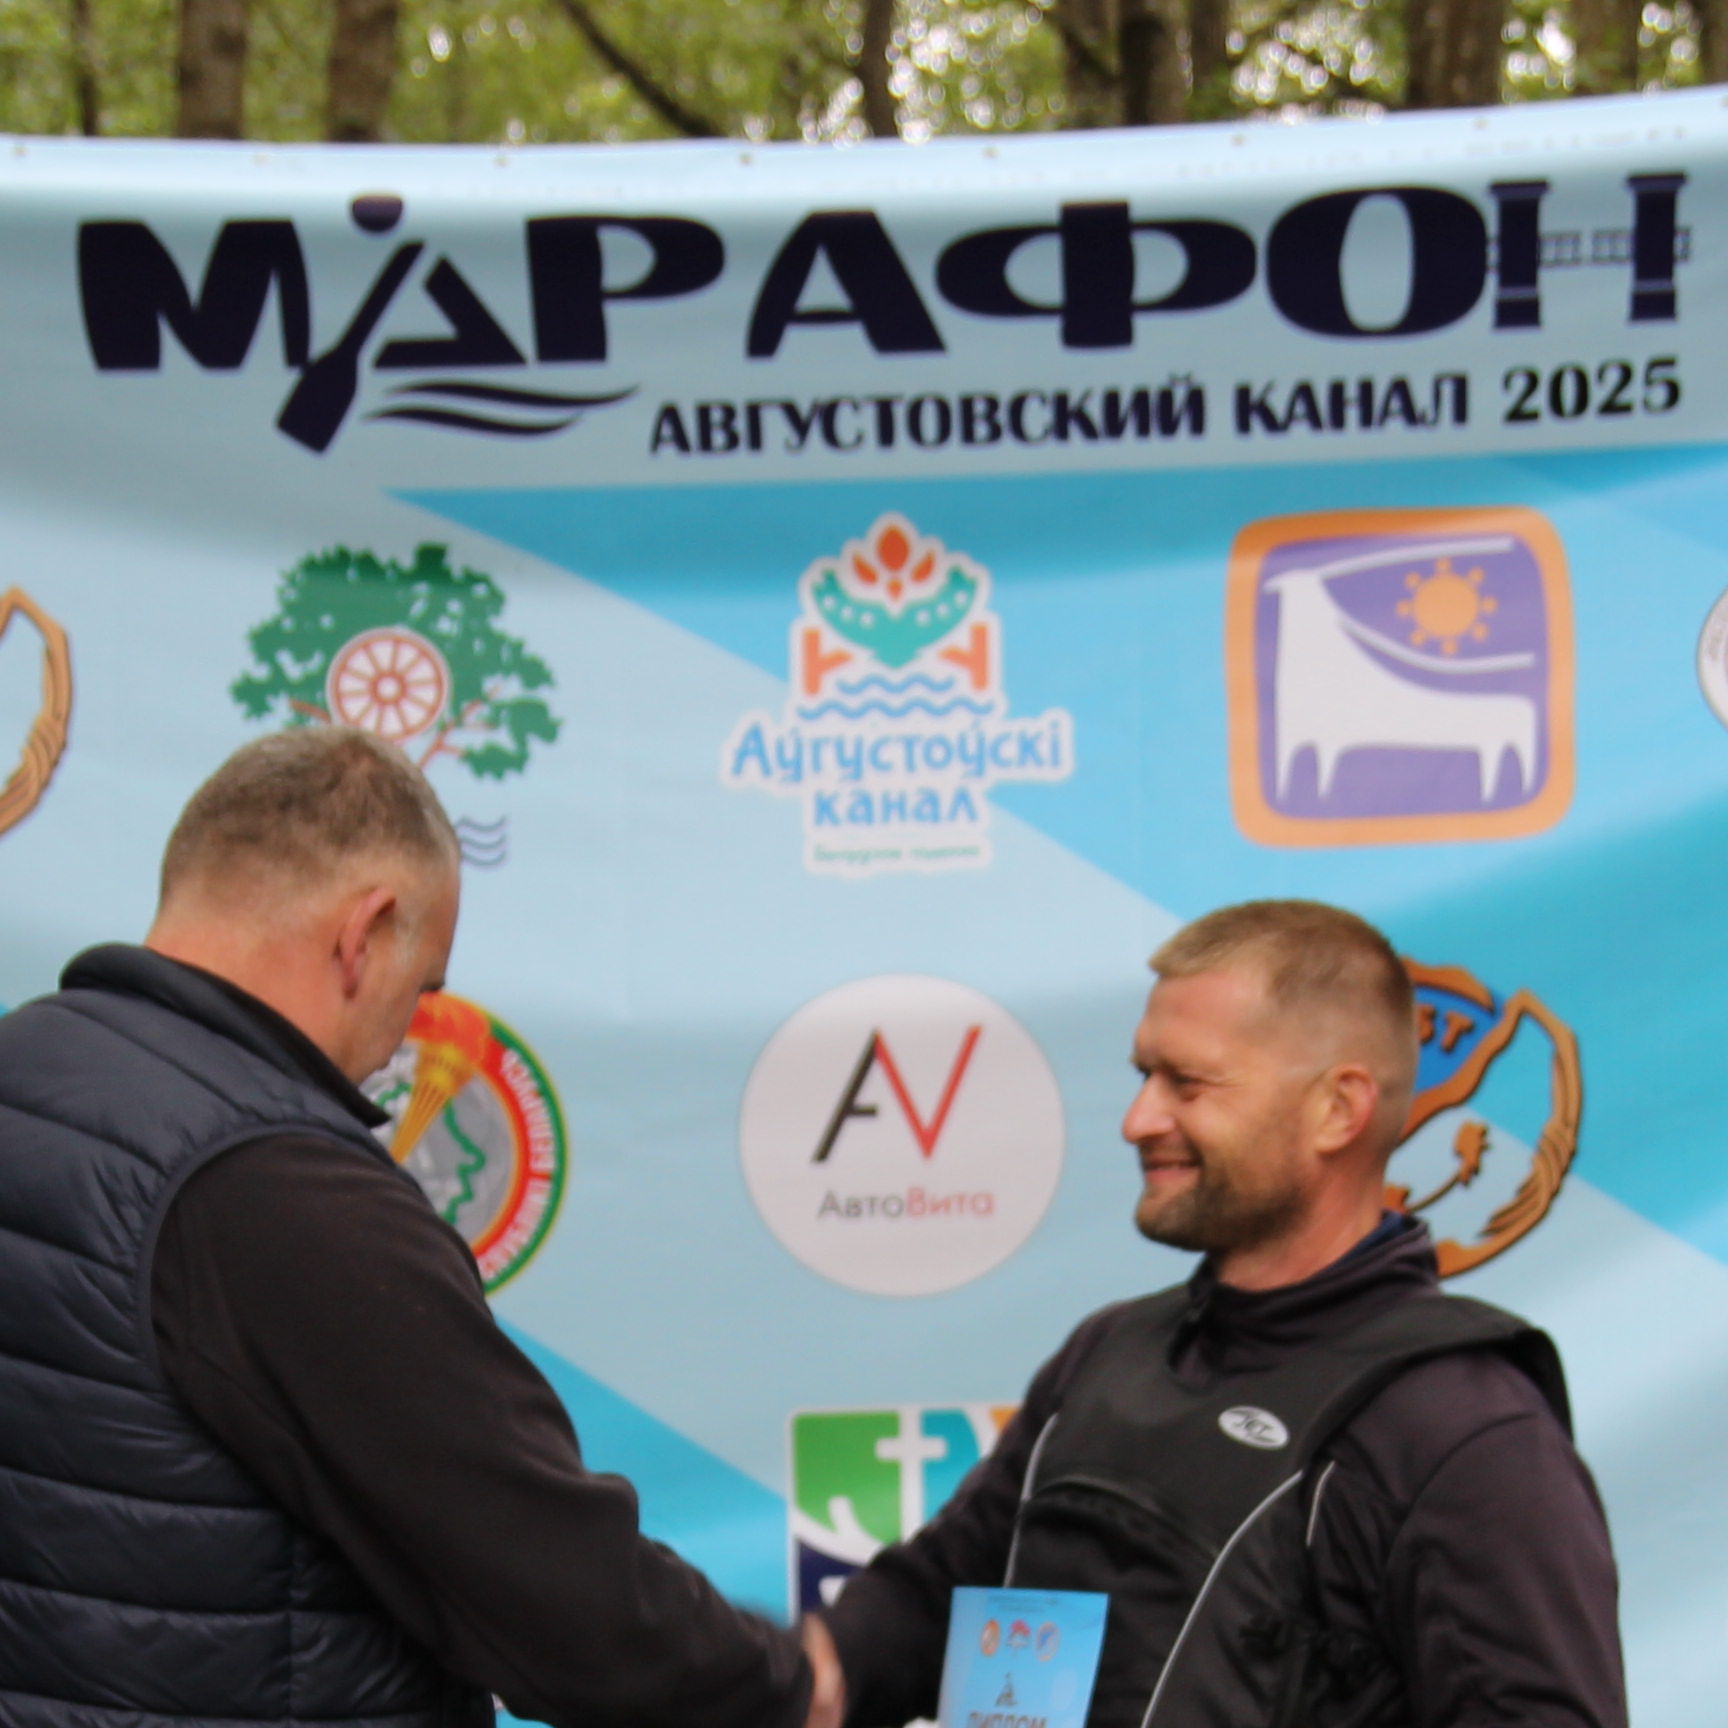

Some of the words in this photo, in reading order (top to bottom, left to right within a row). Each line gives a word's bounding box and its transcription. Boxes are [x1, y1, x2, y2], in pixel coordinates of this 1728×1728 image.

[649, 373, 1206, 454] АВГУСТОВСКИЙ
[1234, 370, 1470, 435] КАНАЛ
[1502, 354, 1681, 424] 2025
[815, 788, 978, 826] канал
[817, 1186, 995, 1218] АвтоВита
